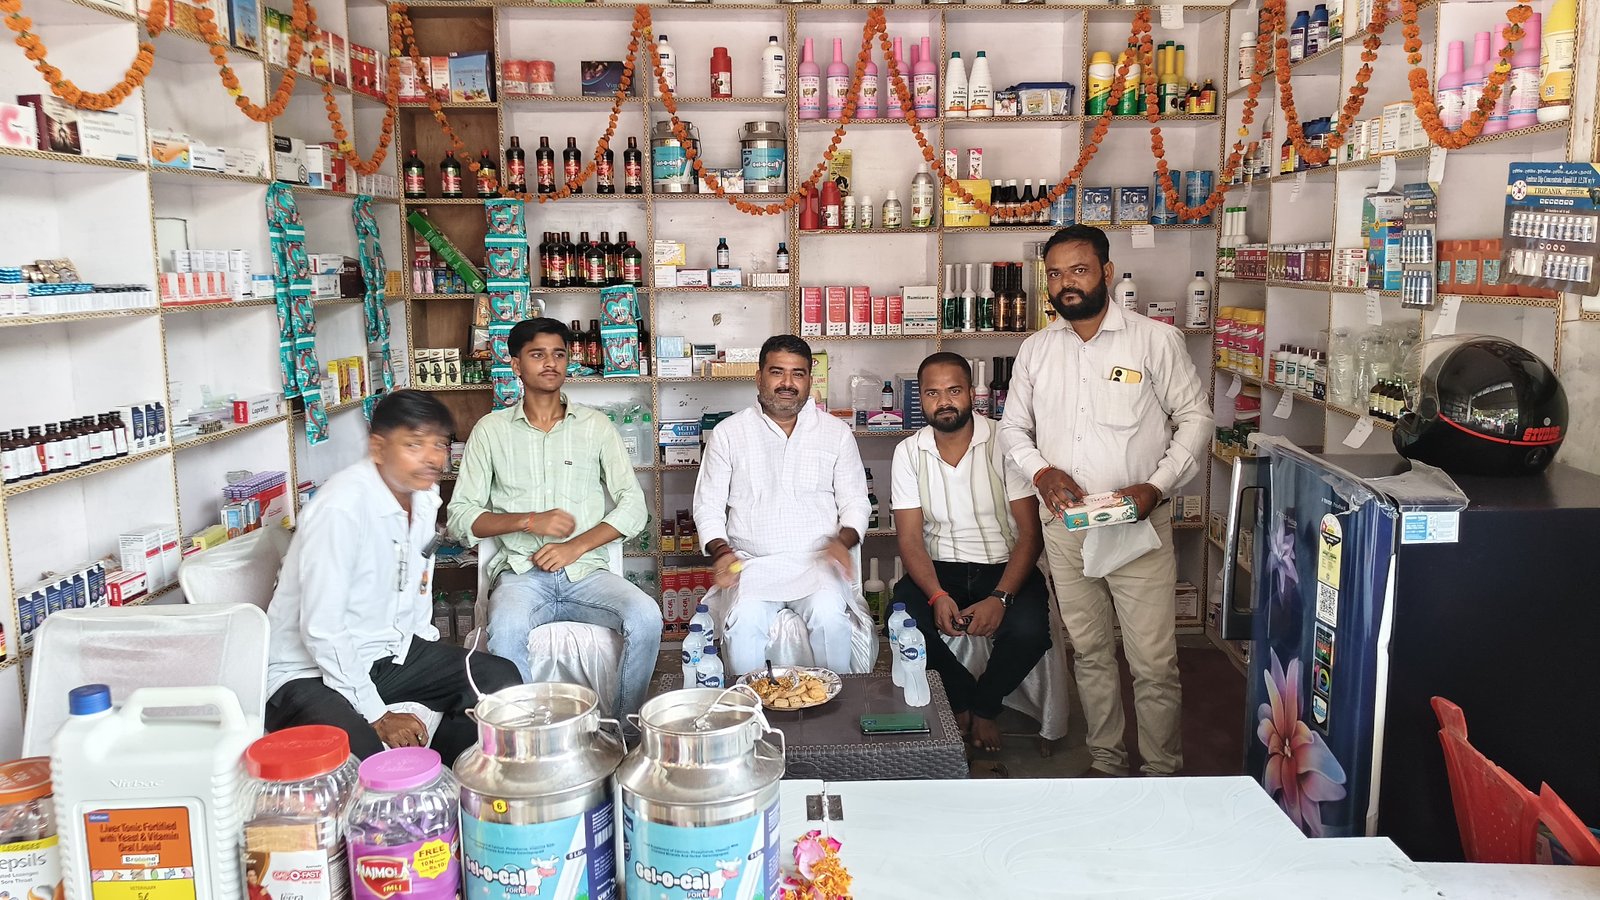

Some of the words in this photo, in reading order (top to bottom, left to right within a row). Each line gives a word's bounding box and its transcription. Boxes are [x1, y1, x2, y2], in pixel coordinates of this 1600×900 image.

[419, 845, 446, 858] FREE
[634, 860, 711, 890] Gel-O-Cal
[383, 884, 402, 893] IMLI
